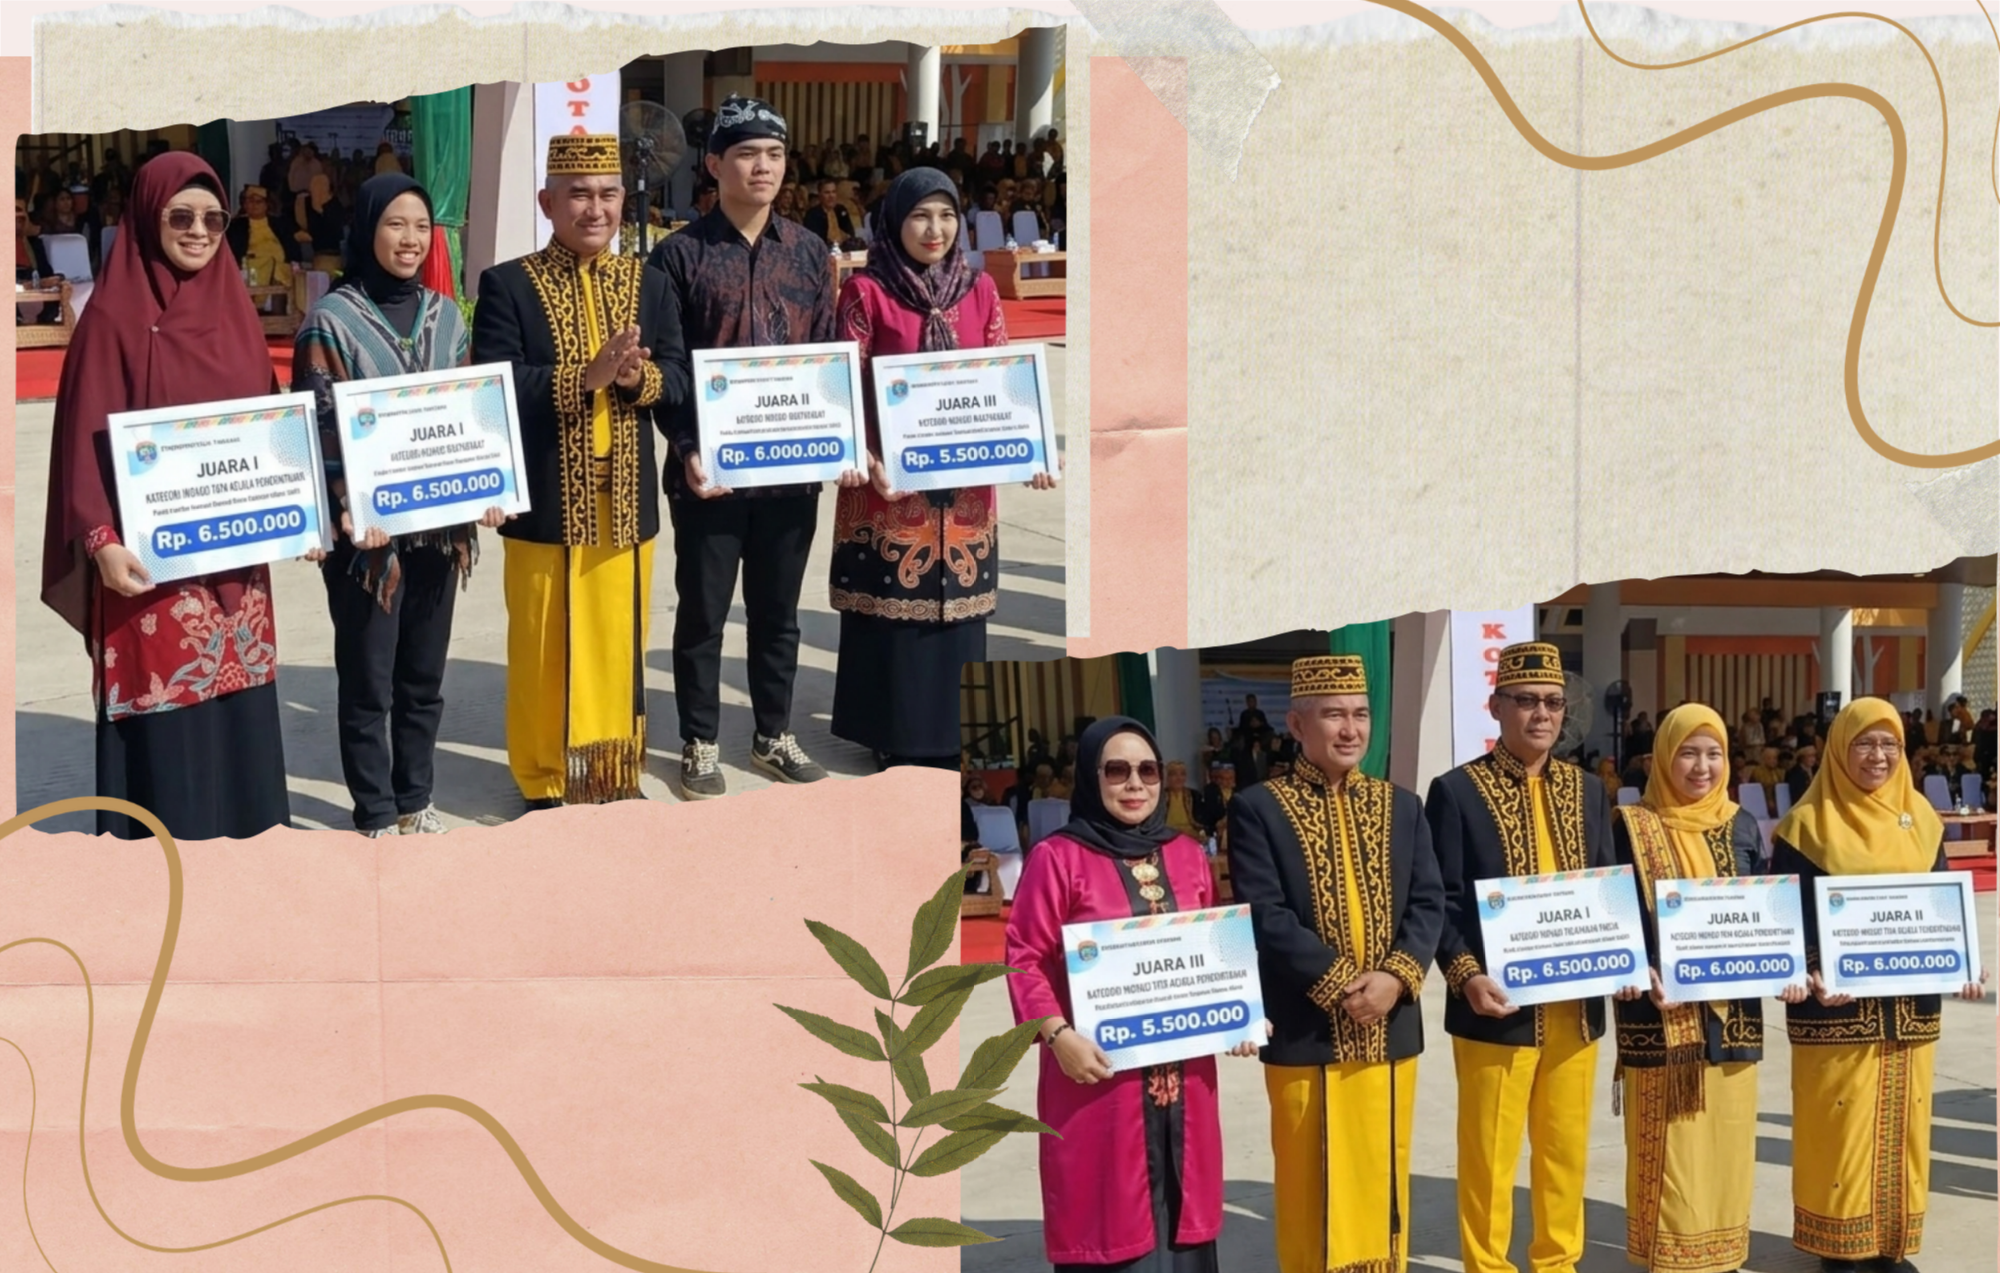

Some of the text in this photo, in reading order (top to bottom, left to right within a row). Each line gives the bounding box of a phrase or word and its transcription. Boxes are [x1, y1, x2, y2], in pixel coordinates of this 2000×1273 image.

[755, 394, 809, 408] JUARA II
[936, 395, 996, 411] JUARA III
[410, 422, 465, 442] JUARA I
[722, 442, 839, 465] Rp. 6.000.000
[905, 443, 1028, 468] Rp. 5.500.000
[197, 456, 259, 478] JUARA I
[377, 473, 500, 509] Rp. 6.500.000
[157, 511, 300, 550] Rp. 6.500.000
[1482, 624, 1506, 711] KOT
[1537, 907, 1591, 924] JUARA I
[1707, 912, 1760, 924] JUARA II
[1870, 910, 1923, 922] JUARA II
[1133, 954, 1204, 976] JUARA III
[1507, 954, 1630, 983] Rp. 6.500.000
[1679, 959, 1789, 980] Rp. 6.000.000
[1843, 955, 1955, 974] Rp. 6.000.000
[1101, 1006, 1244, 1044] Rp. 5.500.000
